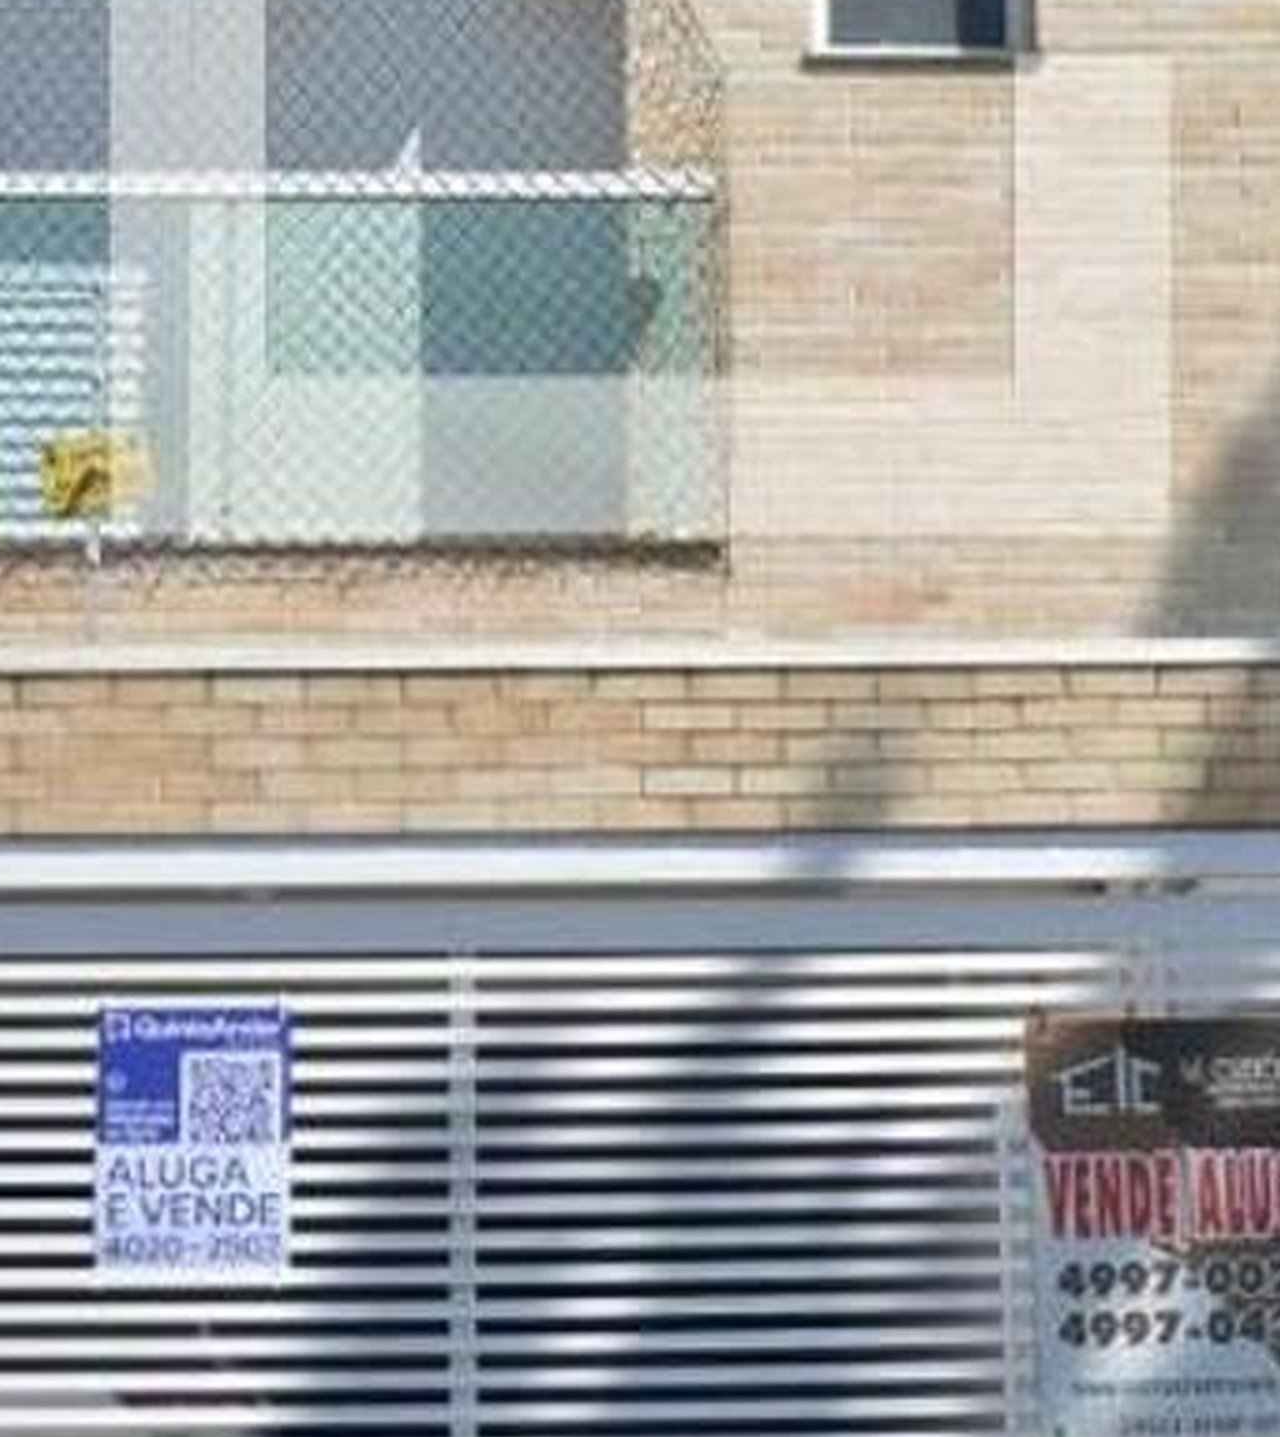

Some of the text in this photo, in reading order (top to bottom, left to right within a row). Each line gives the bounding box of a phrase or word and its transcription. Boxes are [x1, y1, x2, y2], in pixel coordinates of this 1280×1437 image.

[108, 1154, 252, 1190] ALUGA
[140, 1192, 281, 1228] VENDE
[1045, 1148, 1179, 1239] VENDE
